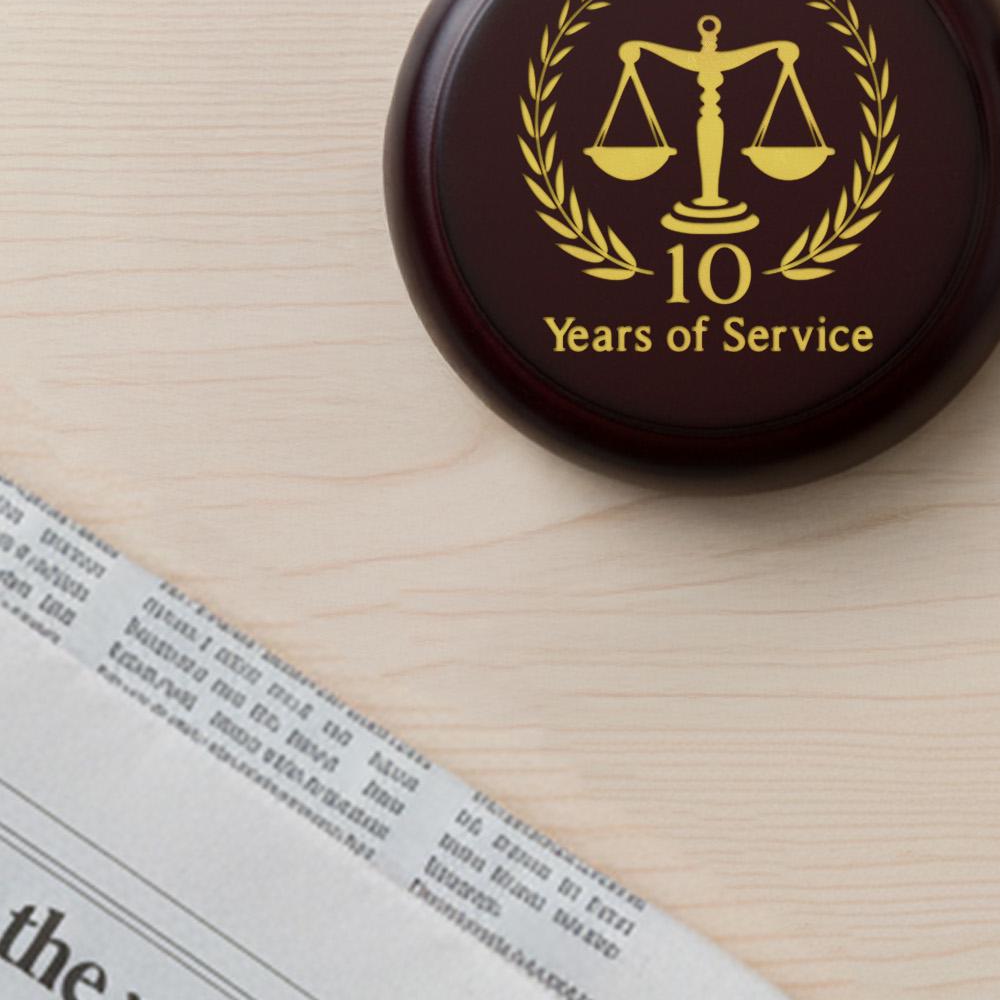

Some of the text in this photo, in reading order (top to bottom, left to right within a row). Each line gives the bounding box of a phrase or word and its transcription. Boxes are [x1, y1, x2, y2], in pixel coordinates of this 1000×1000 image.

[667, 243, 752, 305] 10
[543, 315, 874, 353] Years of Service
[0, 904, 107, 1000] the
